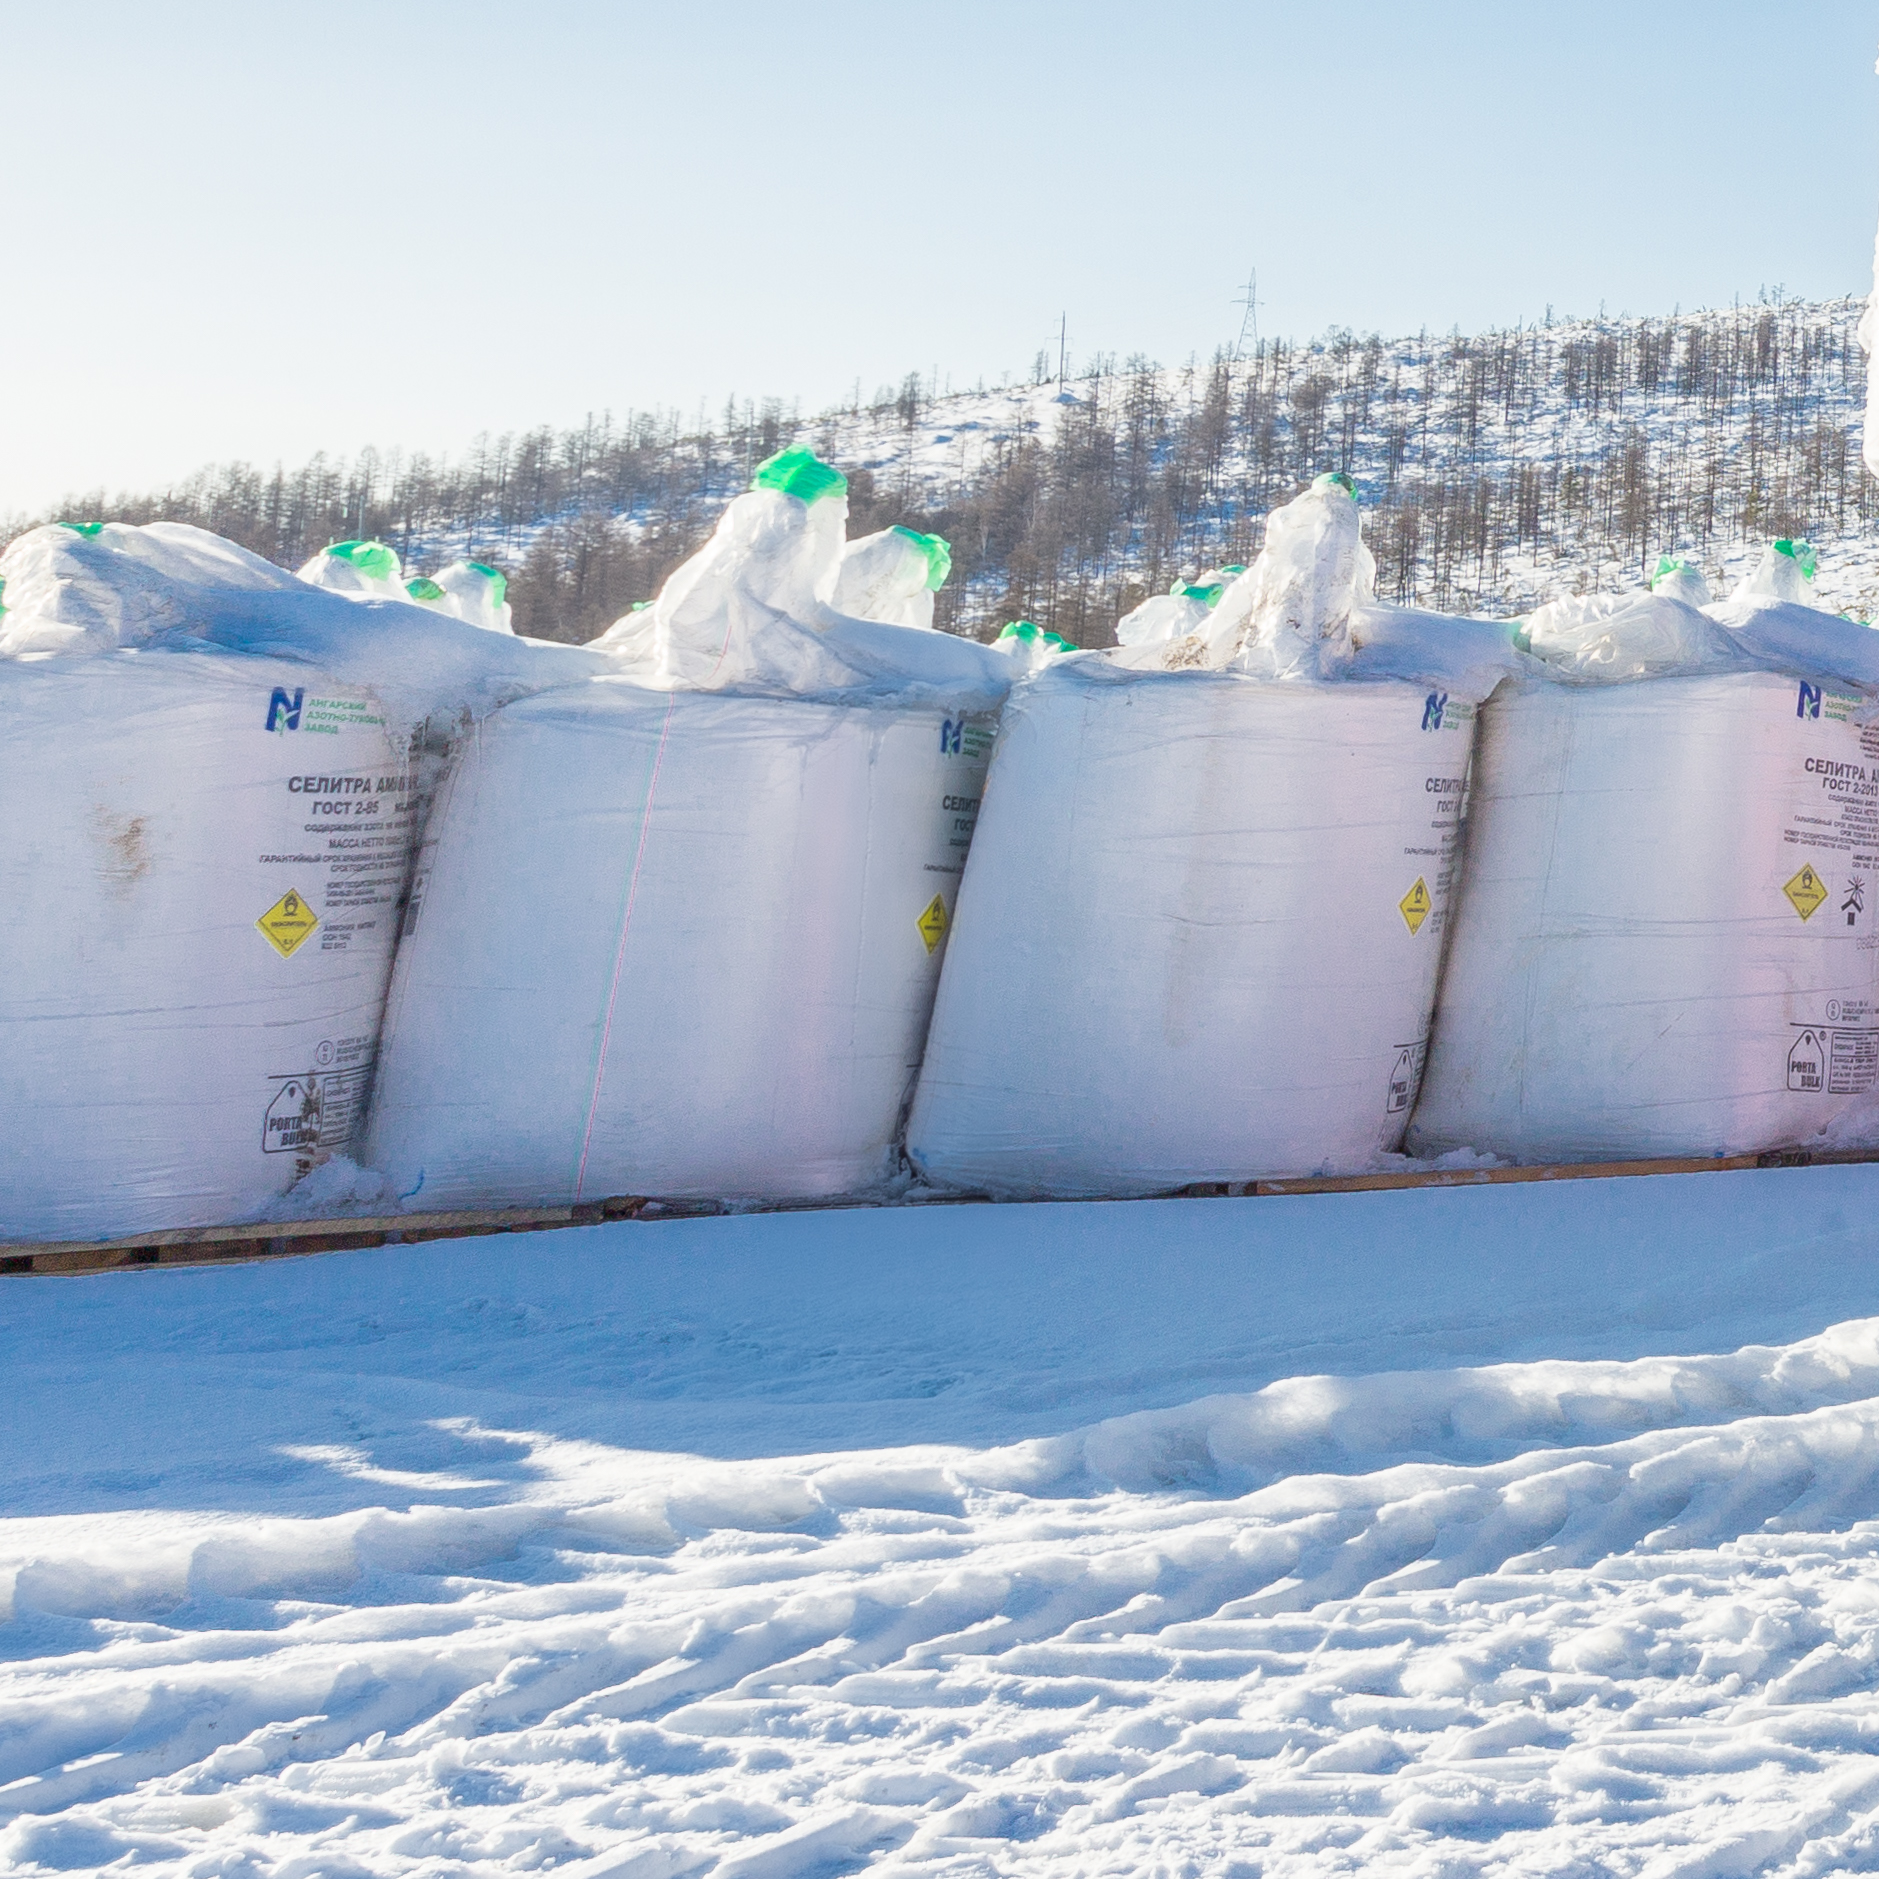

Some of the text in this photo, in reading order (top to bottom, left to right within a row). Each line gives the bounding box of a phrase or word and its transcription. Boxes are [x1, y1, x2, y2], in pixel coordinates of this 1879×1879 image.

[1804, 757, 1866, 781] СЕЛИТРА
[288, 776, 371, 794] СЕЛИТРА
[1822, 777, 1879, 797] ГОСТ 2-2013
[312, 801, 351, 815] ГОСТ
[354, 801, 379, 815] 2-85
